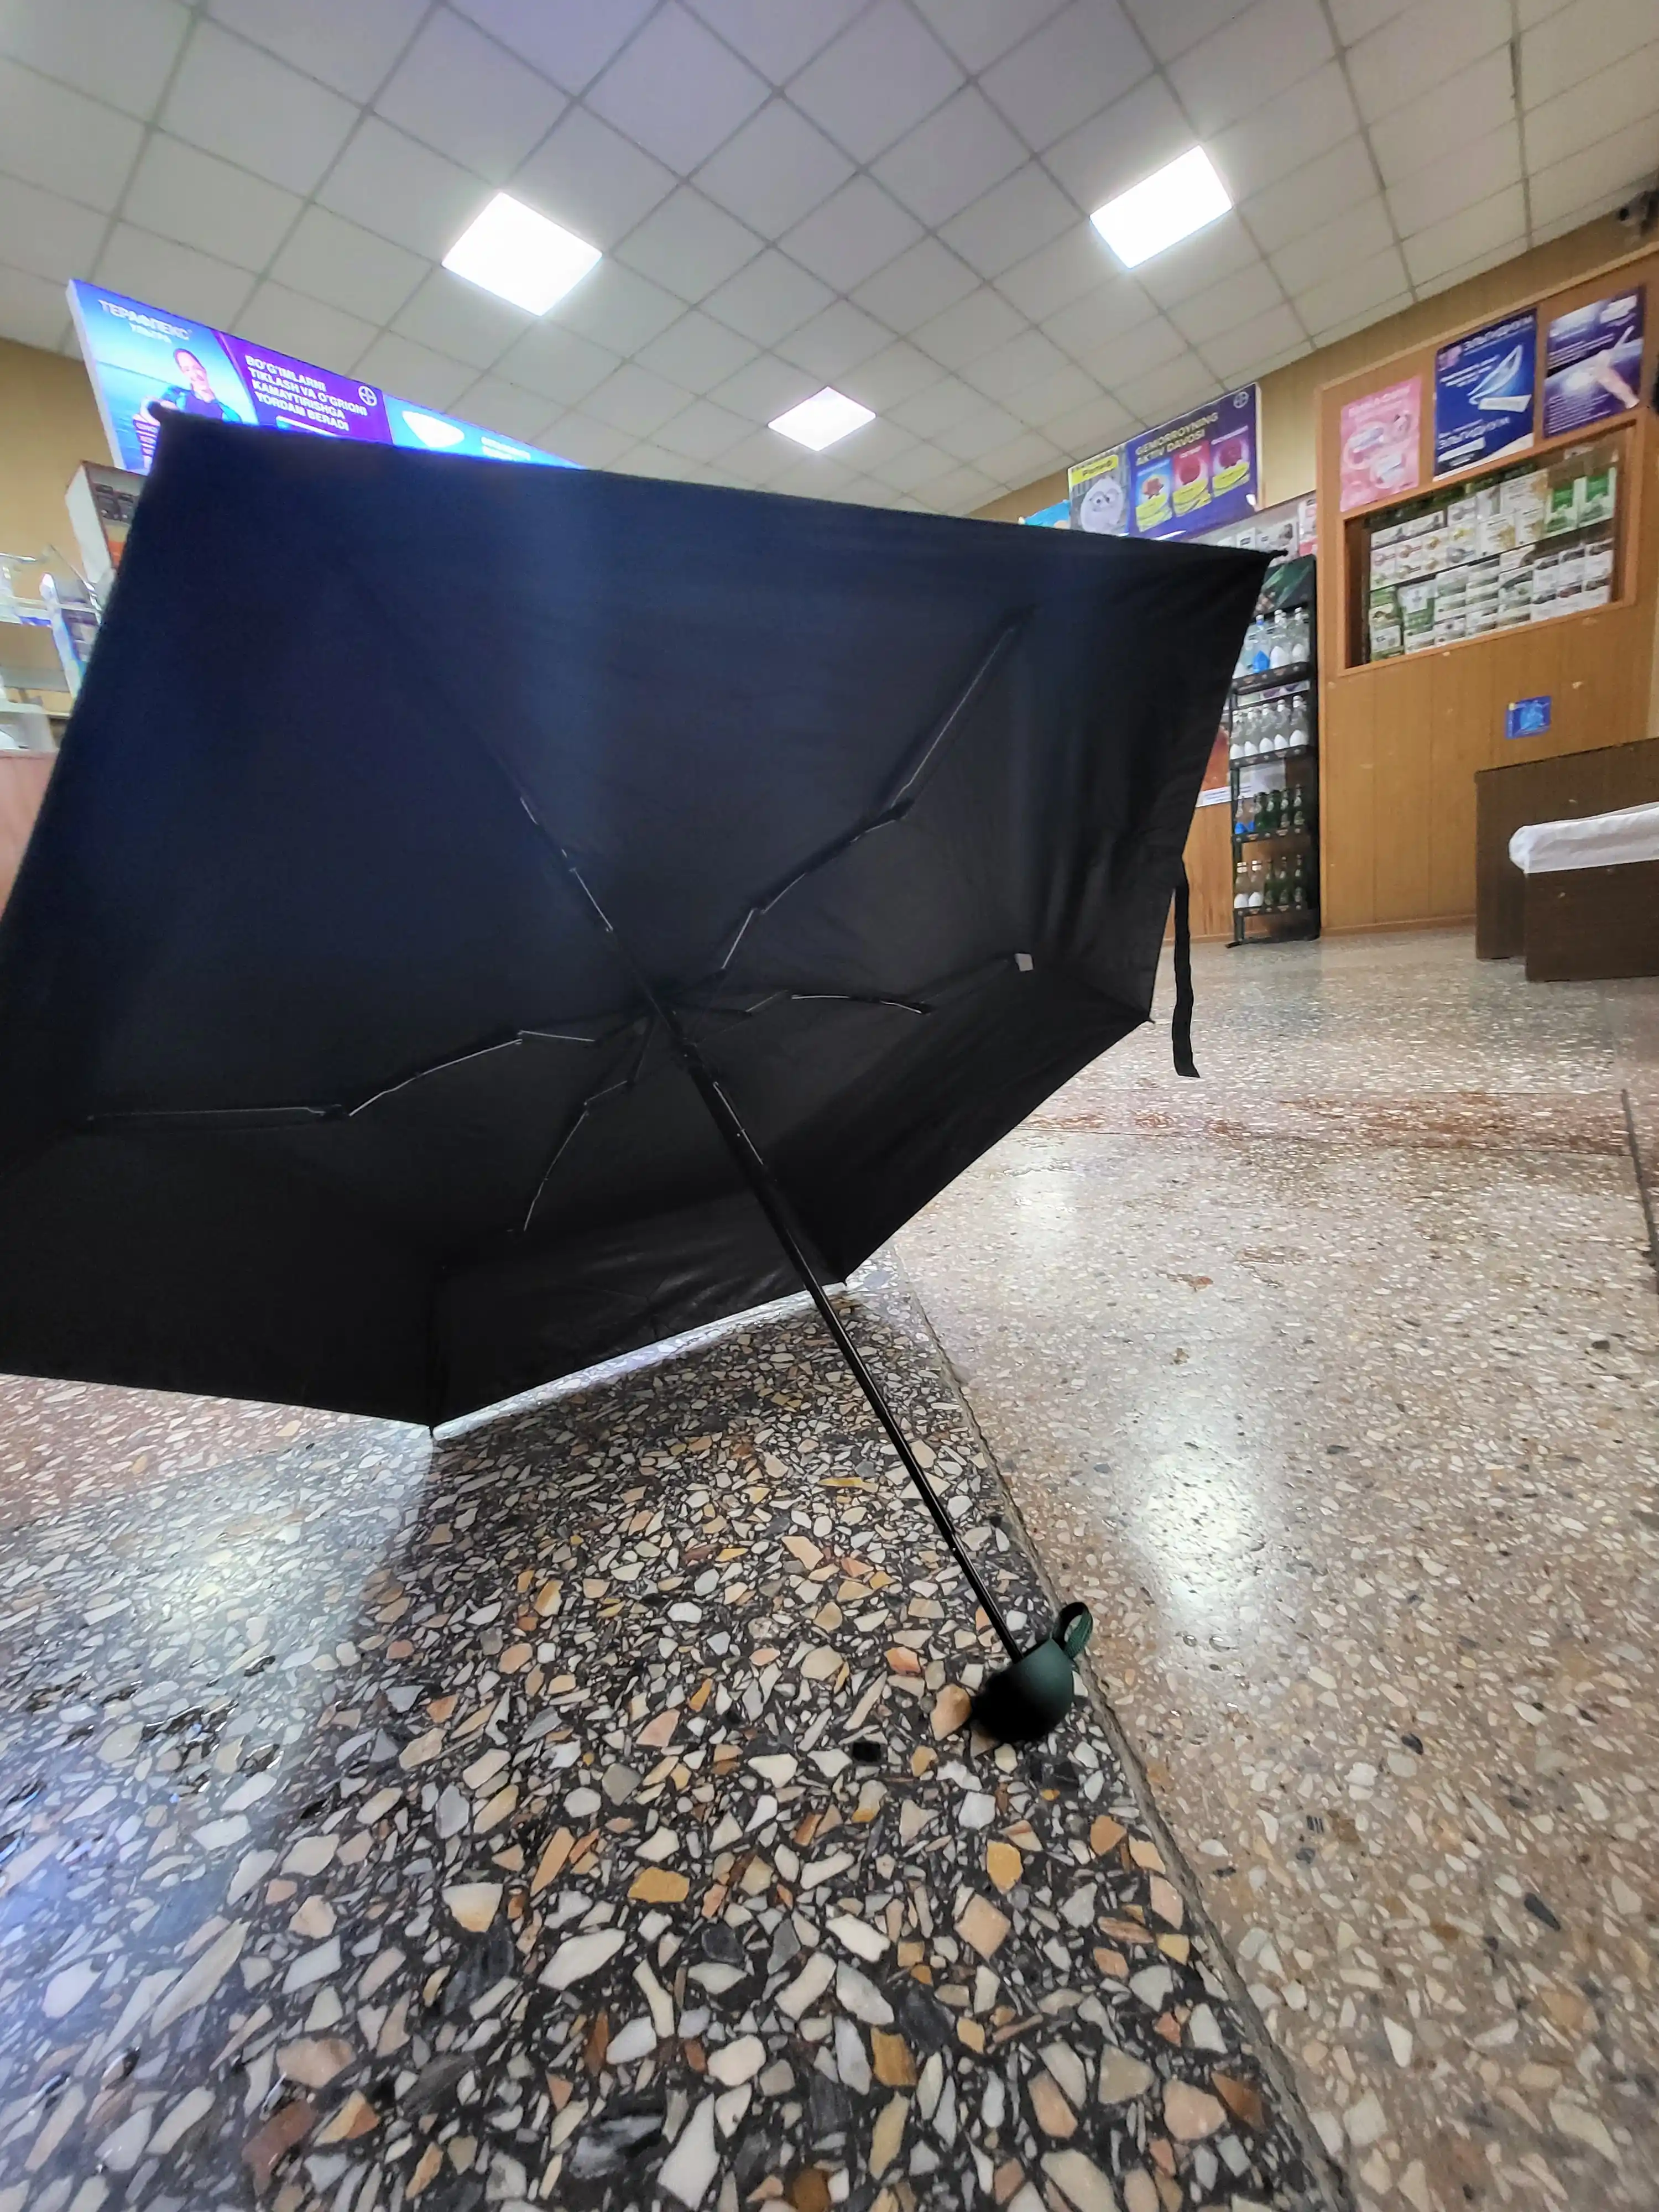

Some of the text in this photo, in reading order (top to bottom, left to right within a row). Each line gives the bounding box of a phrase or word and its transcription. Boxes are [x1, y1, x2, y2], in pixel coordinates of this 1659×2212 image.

[248, 367, 300, 393] TIKLASH
[300, 385, 317, 399] VA
[254, 391, 349, 431] YORDAM BERADI
